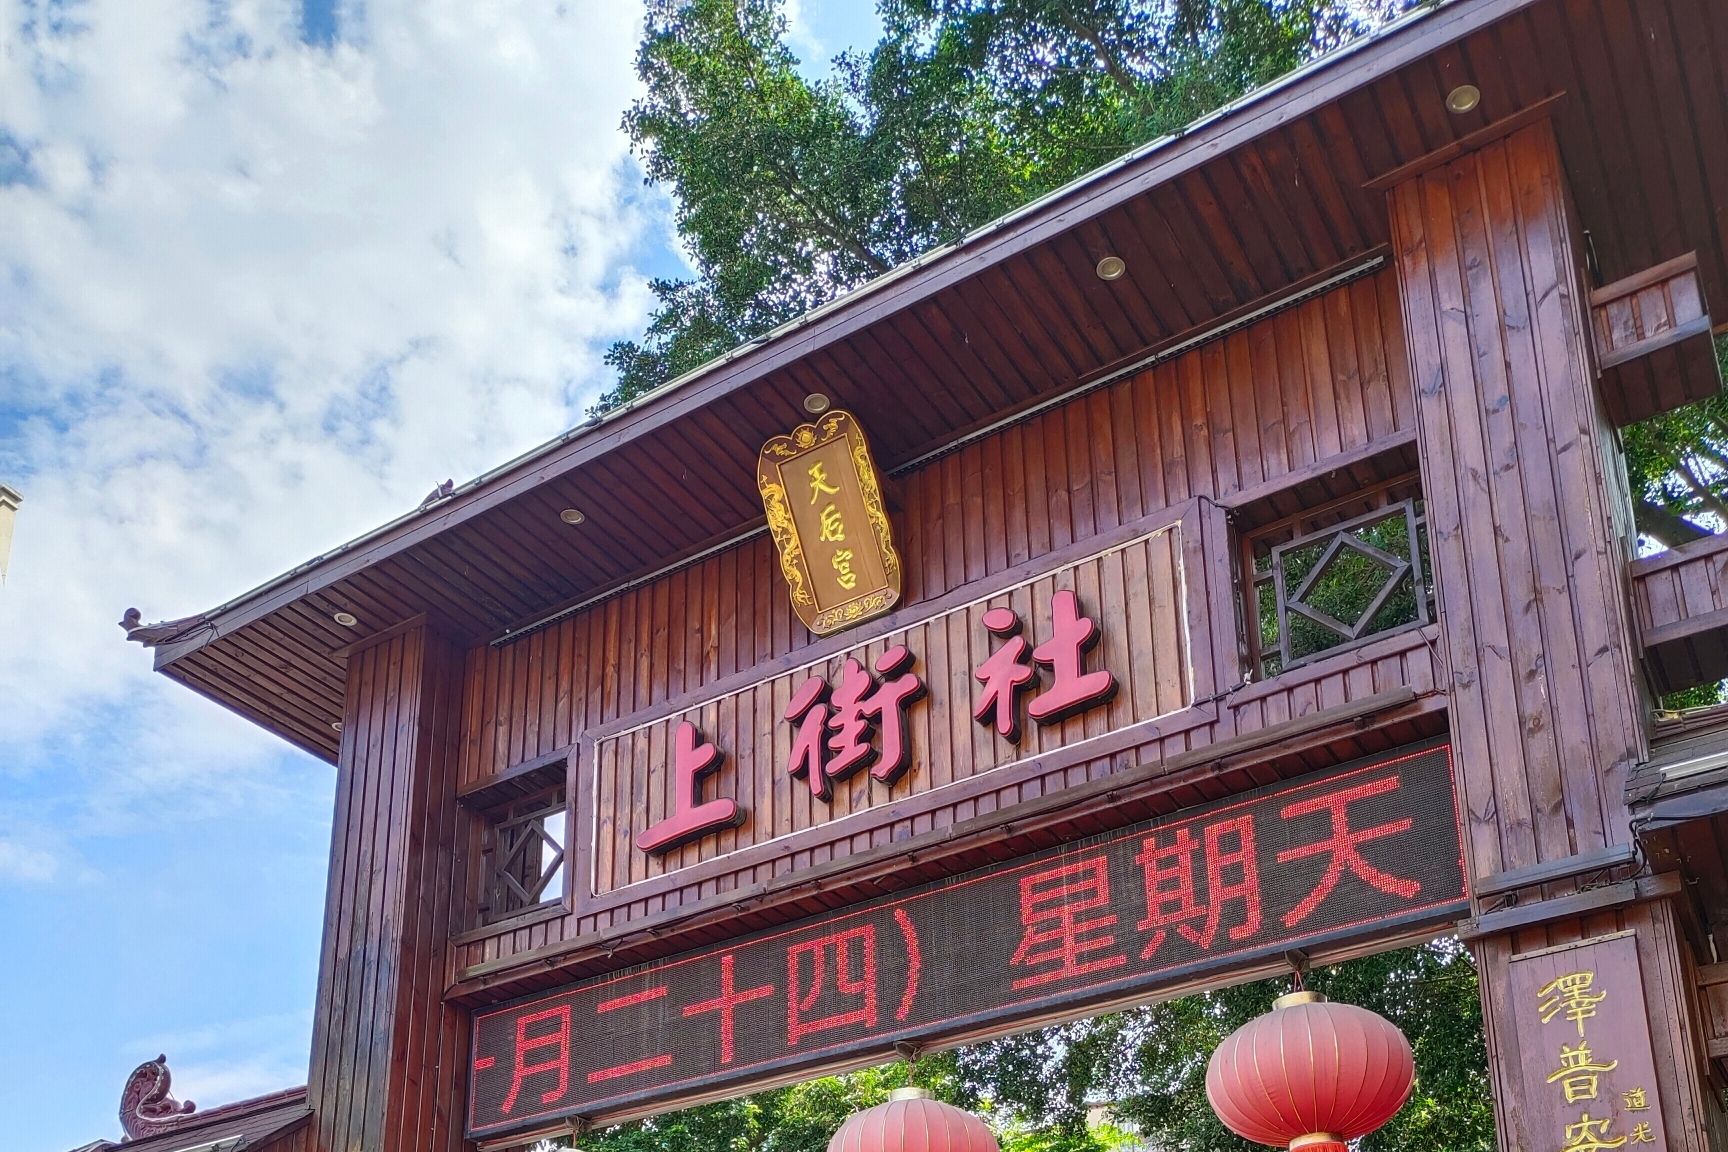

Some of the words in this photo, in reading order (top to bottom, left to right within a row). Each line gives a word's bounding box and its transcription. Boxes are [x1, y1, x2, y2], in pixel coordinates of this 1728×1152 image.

[636, 589, 1118, 856] 上街社
[1010, 776, 1420, 990] 星期天
